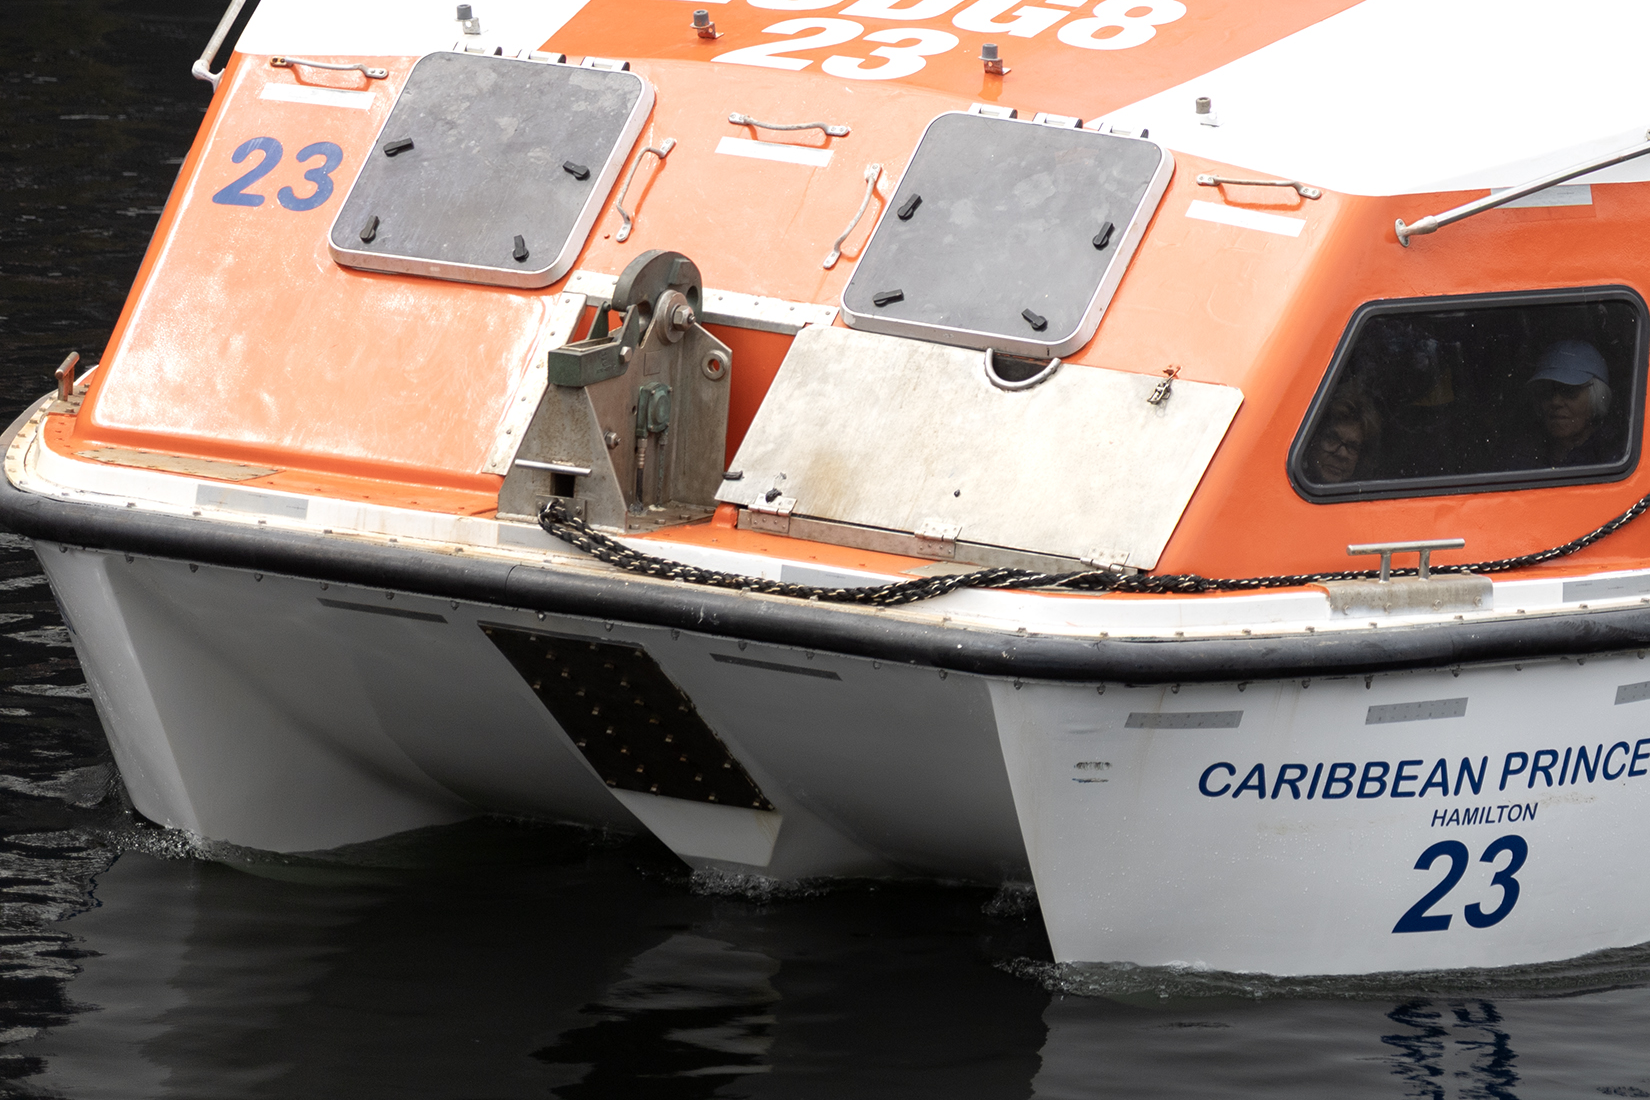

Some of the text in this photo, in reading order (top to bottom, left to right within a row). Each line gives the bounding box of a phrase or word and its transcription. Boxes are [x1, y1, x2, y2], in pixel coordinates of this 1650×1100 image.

[710, 17, 960, 81] 23
[212, 137, 343, 211] 23
[1198, 756, 1488, 800] CARIBBEAN
[1431, 803, 1537, 827] HAMILTON
[1392, 834, 1529, 933] 23
